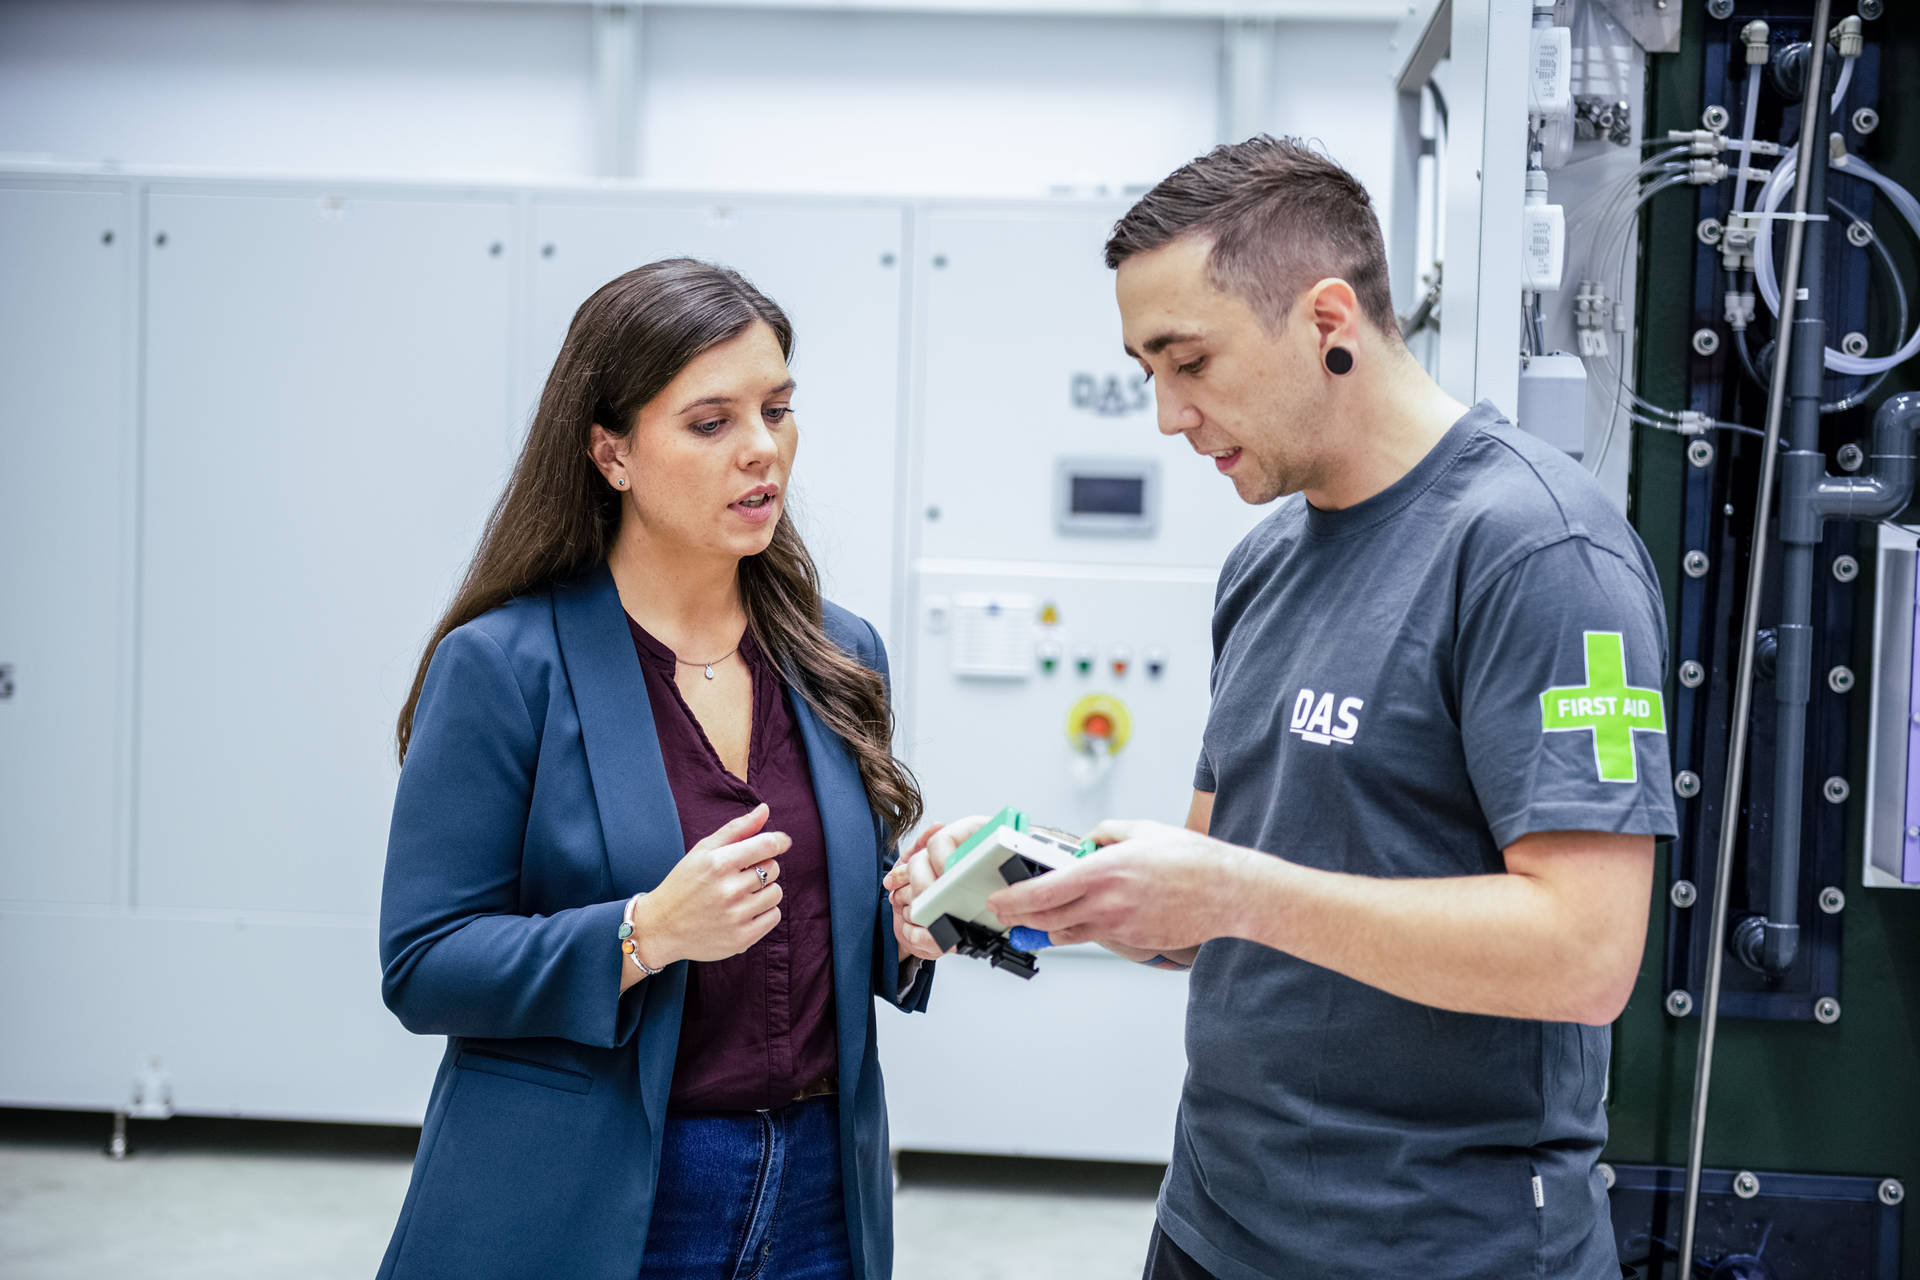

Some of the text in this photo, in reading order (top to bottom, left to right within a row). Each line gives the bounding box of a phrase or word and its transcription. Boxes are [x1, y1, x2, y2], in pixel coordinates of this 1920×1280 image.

[1071, 373, 1151, 414] DAS
[1290, 688, 1364, 741] DAS
[1558, 696, 1651, 718] FIRST AID
